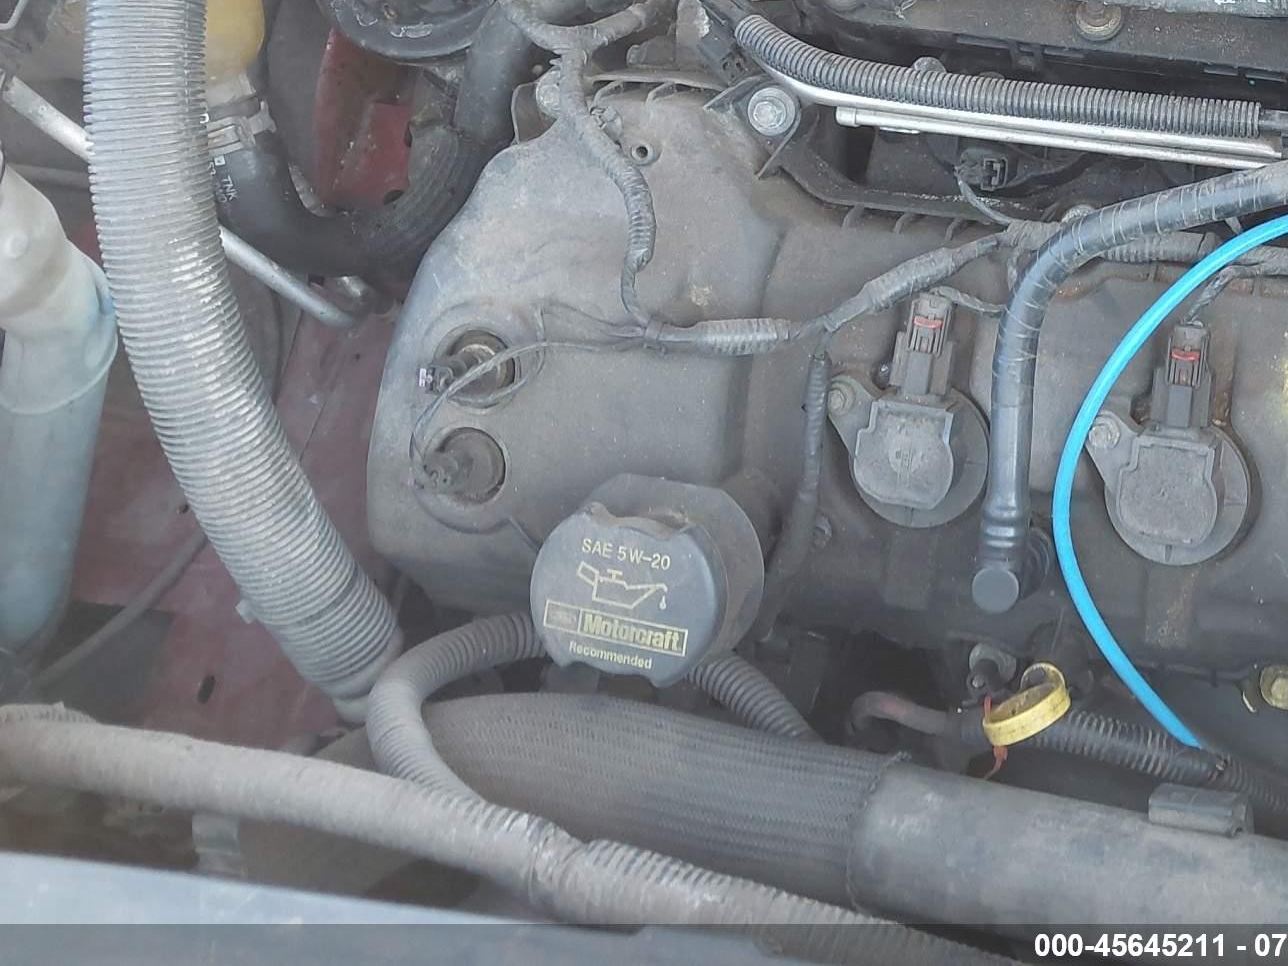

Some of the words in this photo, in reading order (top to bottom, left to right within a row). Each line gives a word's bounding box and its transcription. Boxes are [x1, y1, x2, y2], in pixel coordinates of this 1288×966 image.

[582, 538, 613, 557] SAE
[583, 613, 681, 652] Motorcraft
[569, 641, 652, 669] Recommended
